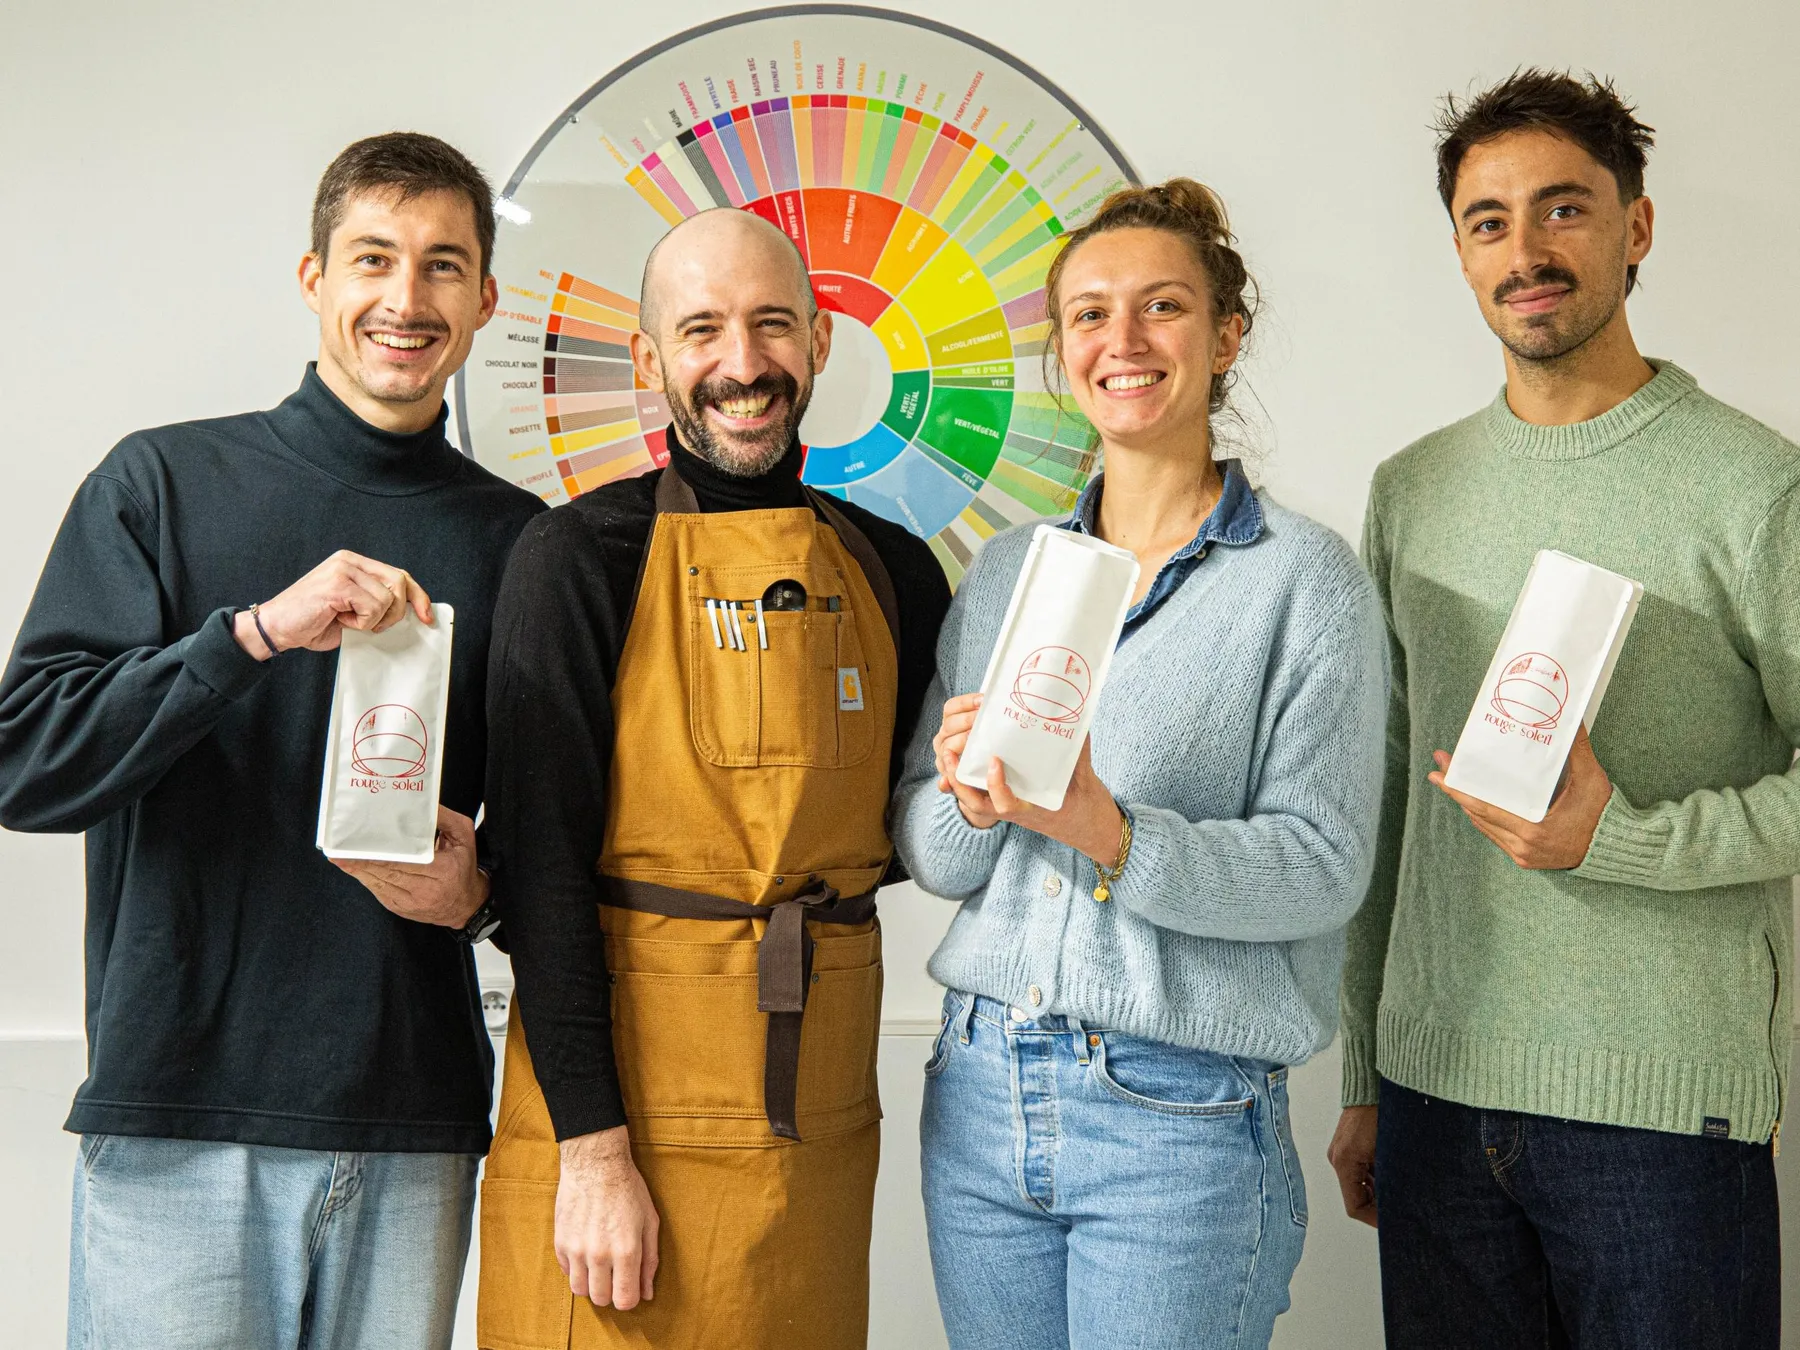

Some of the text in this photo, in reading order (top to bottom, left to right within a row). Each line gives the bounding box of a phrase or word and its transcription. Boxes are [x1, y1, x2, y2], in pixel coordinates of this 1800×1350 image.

[747, 57, 761, 96] RAISIN SEC
[770, 60, 780, 92] PRUNEAU
[816, 64, 824, 89] CERISE
[836, 57, 845, 89] GRENADE
[704, 76, 722, 110] MYRTILLE
[726, 79, 739, 104] FRAISE
[896, 73, 908, 99] POMME
[954, 70, 984, 122] PAMPLEMOUSSE
[678, 80, 700, 120] FRAMBOISE
[668, 108, 683, 129] MÛRE
[971, 106, 990, 132] ORANGE
[785, 196, 800, 238] FRUITS SECS
[842, 194, 857, 245] AUTRES FRUITS
[539, 269, 555, 282] MIEL
[818, 283, 842, 294] FRUITÉ
[495, 308, 543, 326] ROP D'ÉRABLE
[507, 332, 540, 344] MÉLASSE
[485, 359, 538, 370] CHOCOLAT NOIR
[502, 380, 538, 390] CHOCOLAT
[991, 378, 1008, 388] VERT
[642, 404, 659, 415] NOIX
[900, 392, 912, 414] VERT/
[906, 390, 920, 420] VÉGÉTAL
[508, 424, 542, 436] NOISETTE
[954, 416, 1000, 440] VERT/VÉGÉTAL
[526, 468, 554, 484] GIROFLE
[844, 460, 866, 474] AUTRE
[1003, 706, 1075, 740] rouge soleil
[1484, 712, 1552, 746] rouge soleil
[350, 777, 424, 794] rouge soleil
